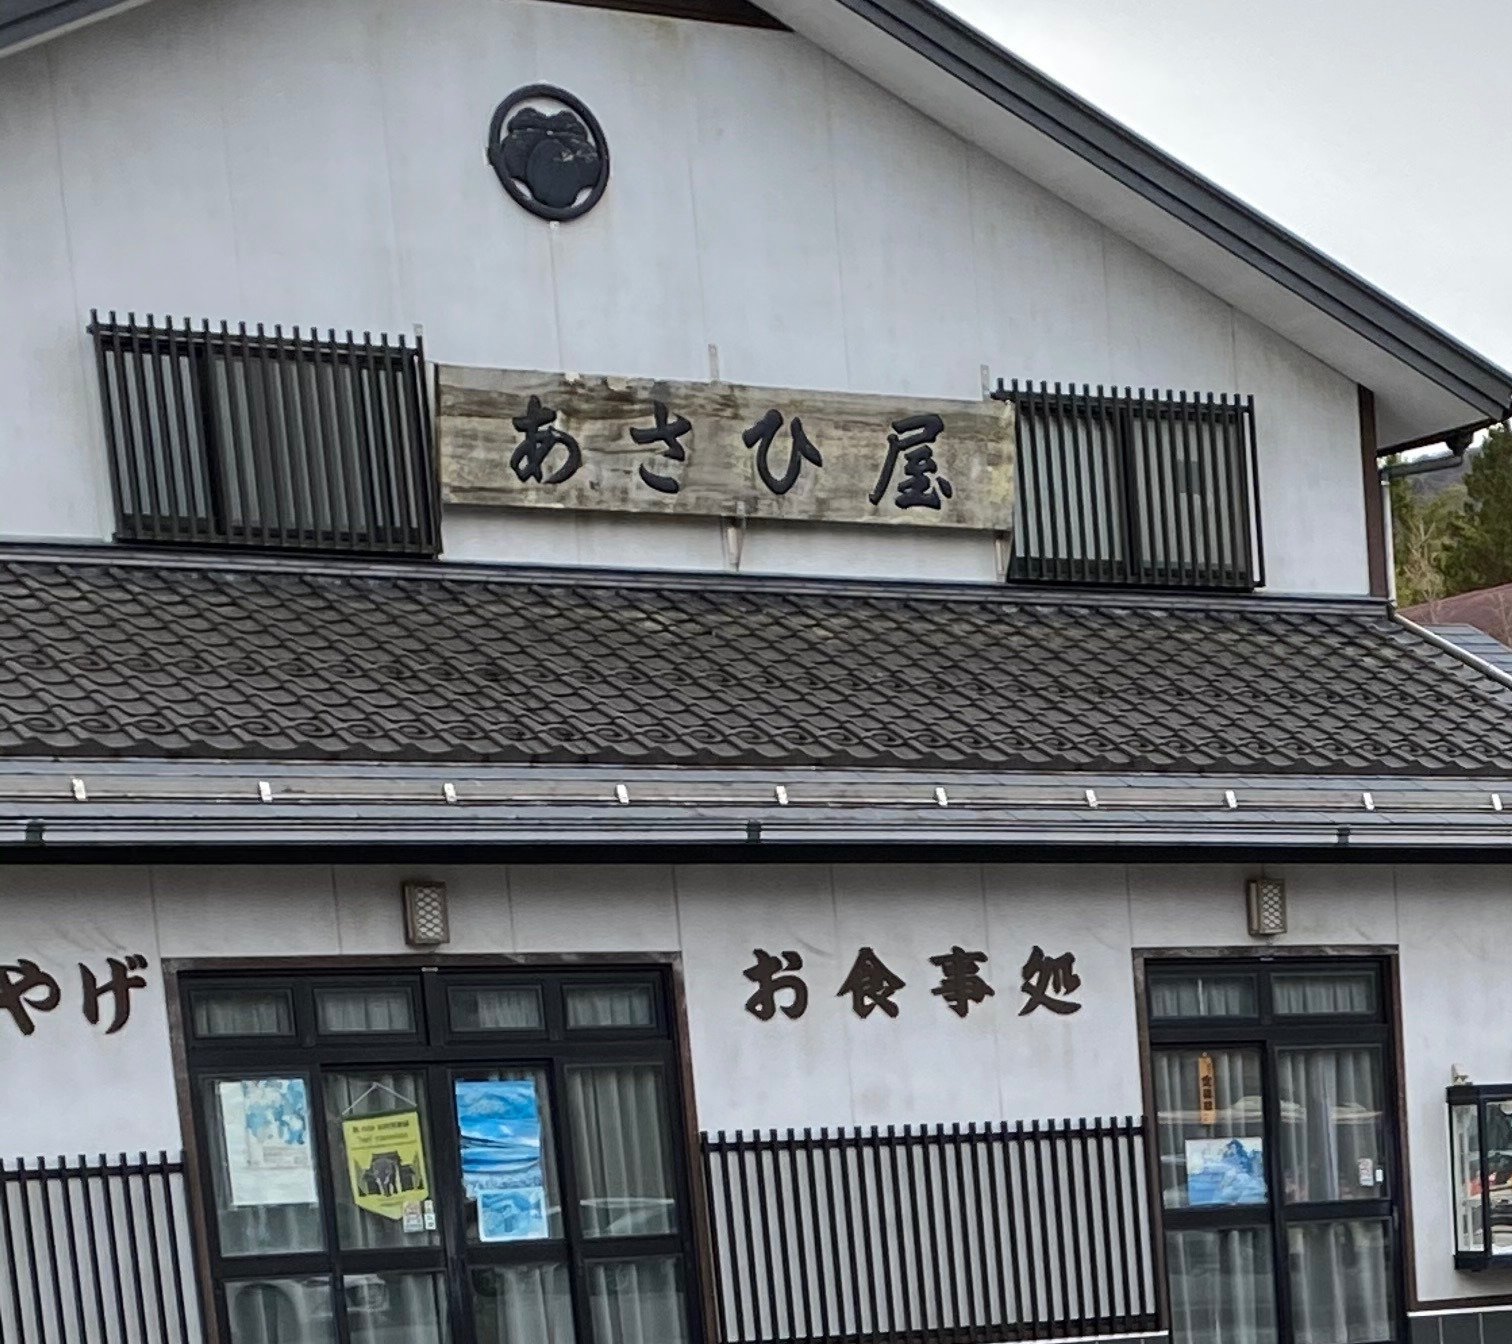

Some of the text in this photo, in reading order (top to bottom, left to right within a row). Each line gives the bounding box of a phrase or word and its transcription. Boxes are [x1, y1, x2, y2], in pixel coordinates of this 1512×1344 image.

[511, 395, 952, 510] あさひ屋
[743, 945, 1082, 1021] お食事処
